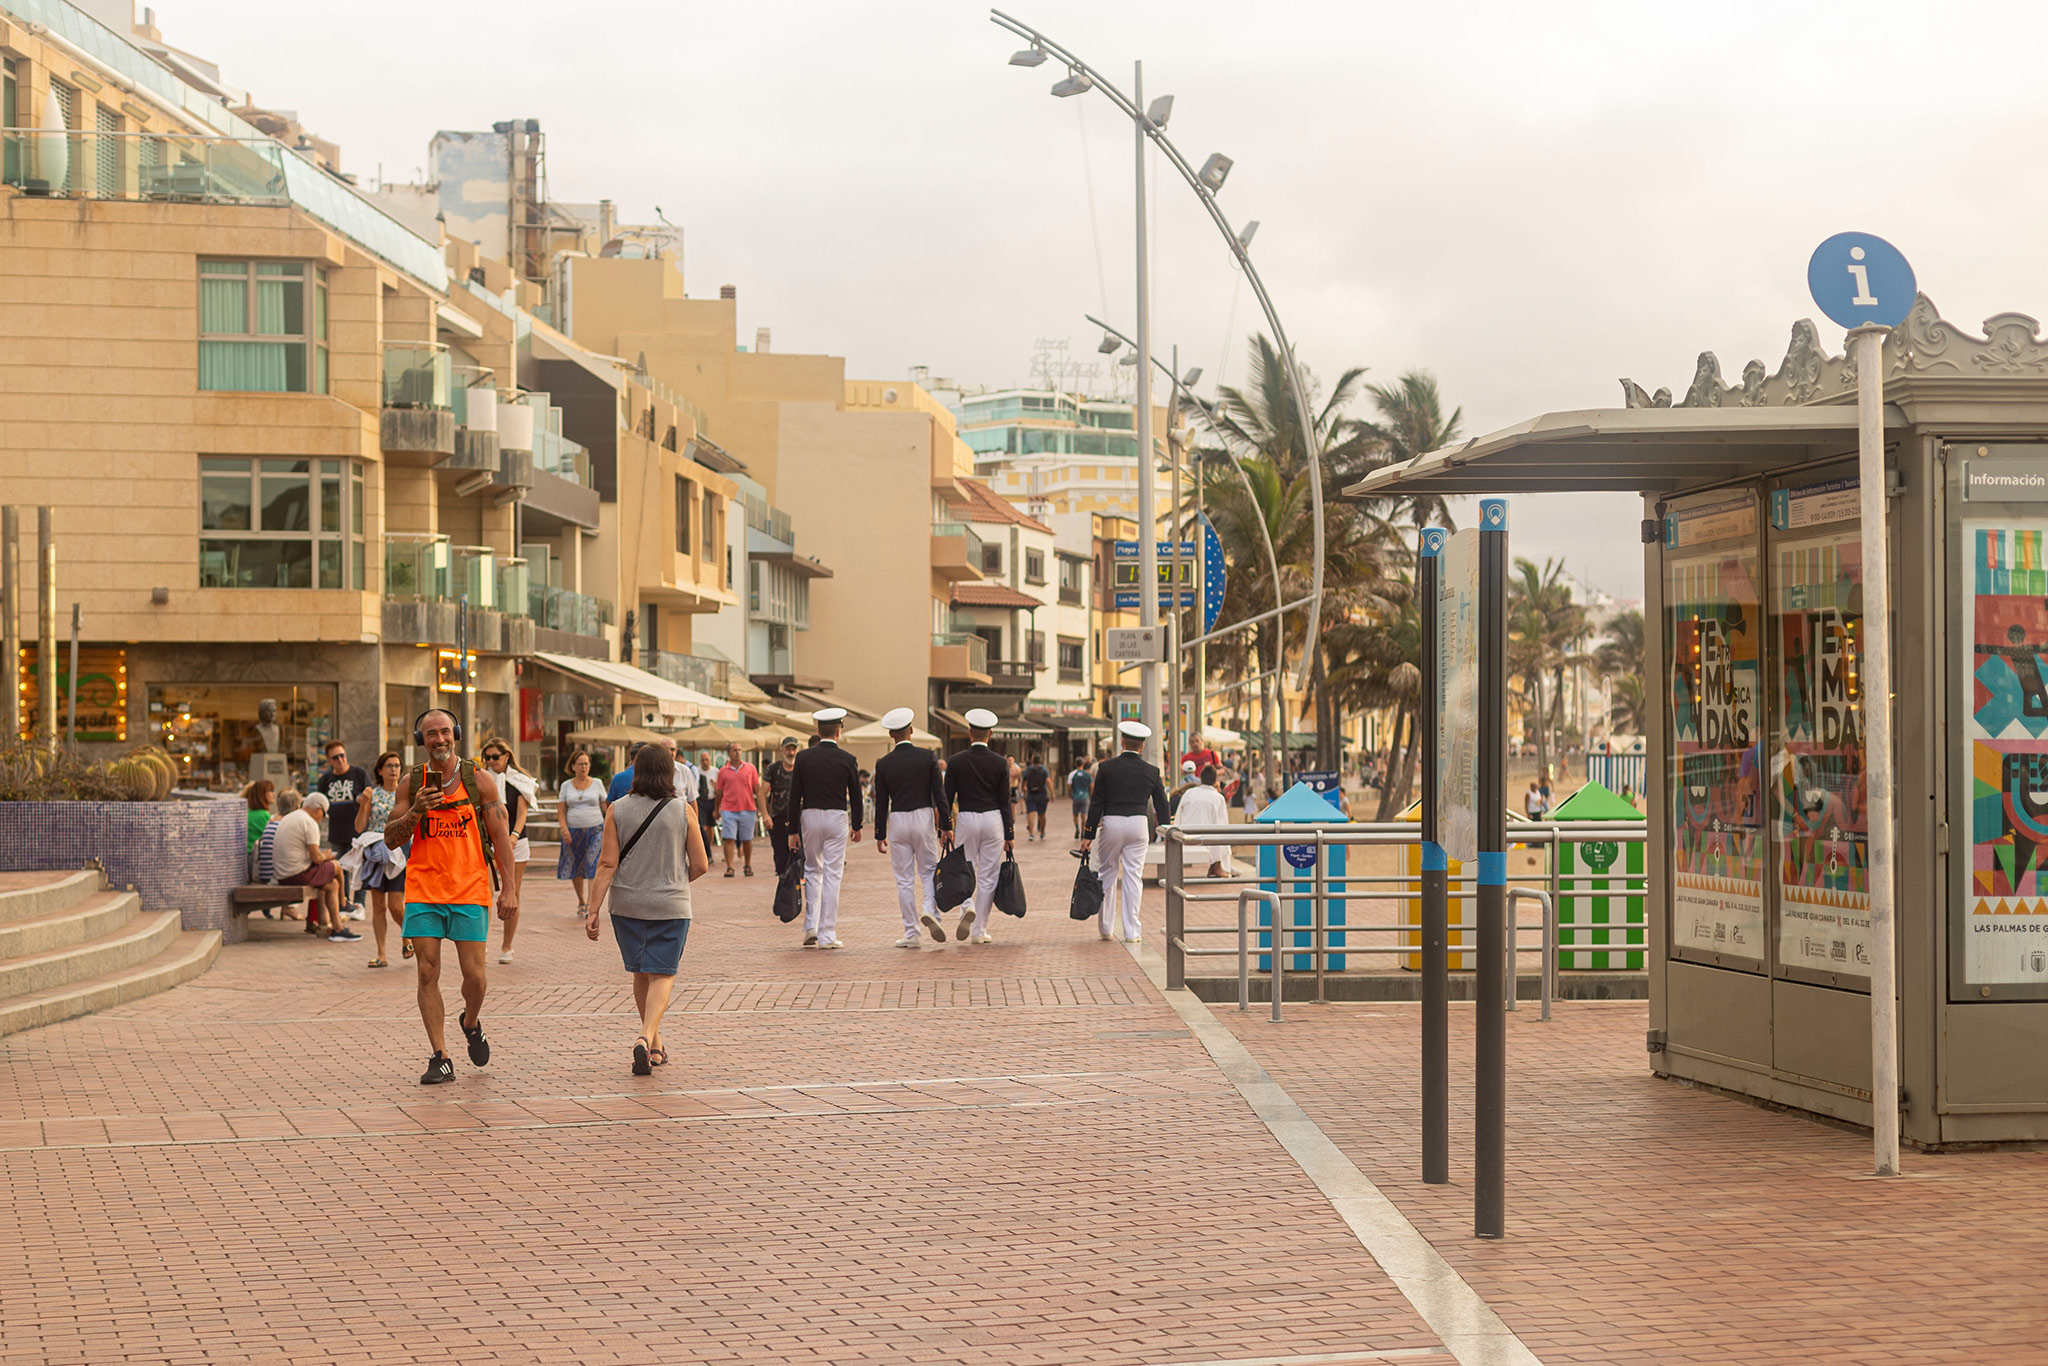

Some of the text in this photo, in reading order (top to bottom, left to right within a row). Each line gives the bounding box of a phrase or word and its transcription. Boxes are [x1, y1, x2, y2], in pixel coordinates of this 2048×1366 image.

[1970, 474, 2045, 486] Información
[1117, 545, 1137, 555] Playa
[1119, 641, 1137, 649] DE LAS
[1115, 650, 1141, 658] CANTERAS
[328, 780, 354, 791] SAVE
[328, 790, 354, 802] SEA
[1974, 924, 1991, 933] LAS
[1993, 924, 2028, 933] PALMAS
[2029, 924, 2041, 933] DE
